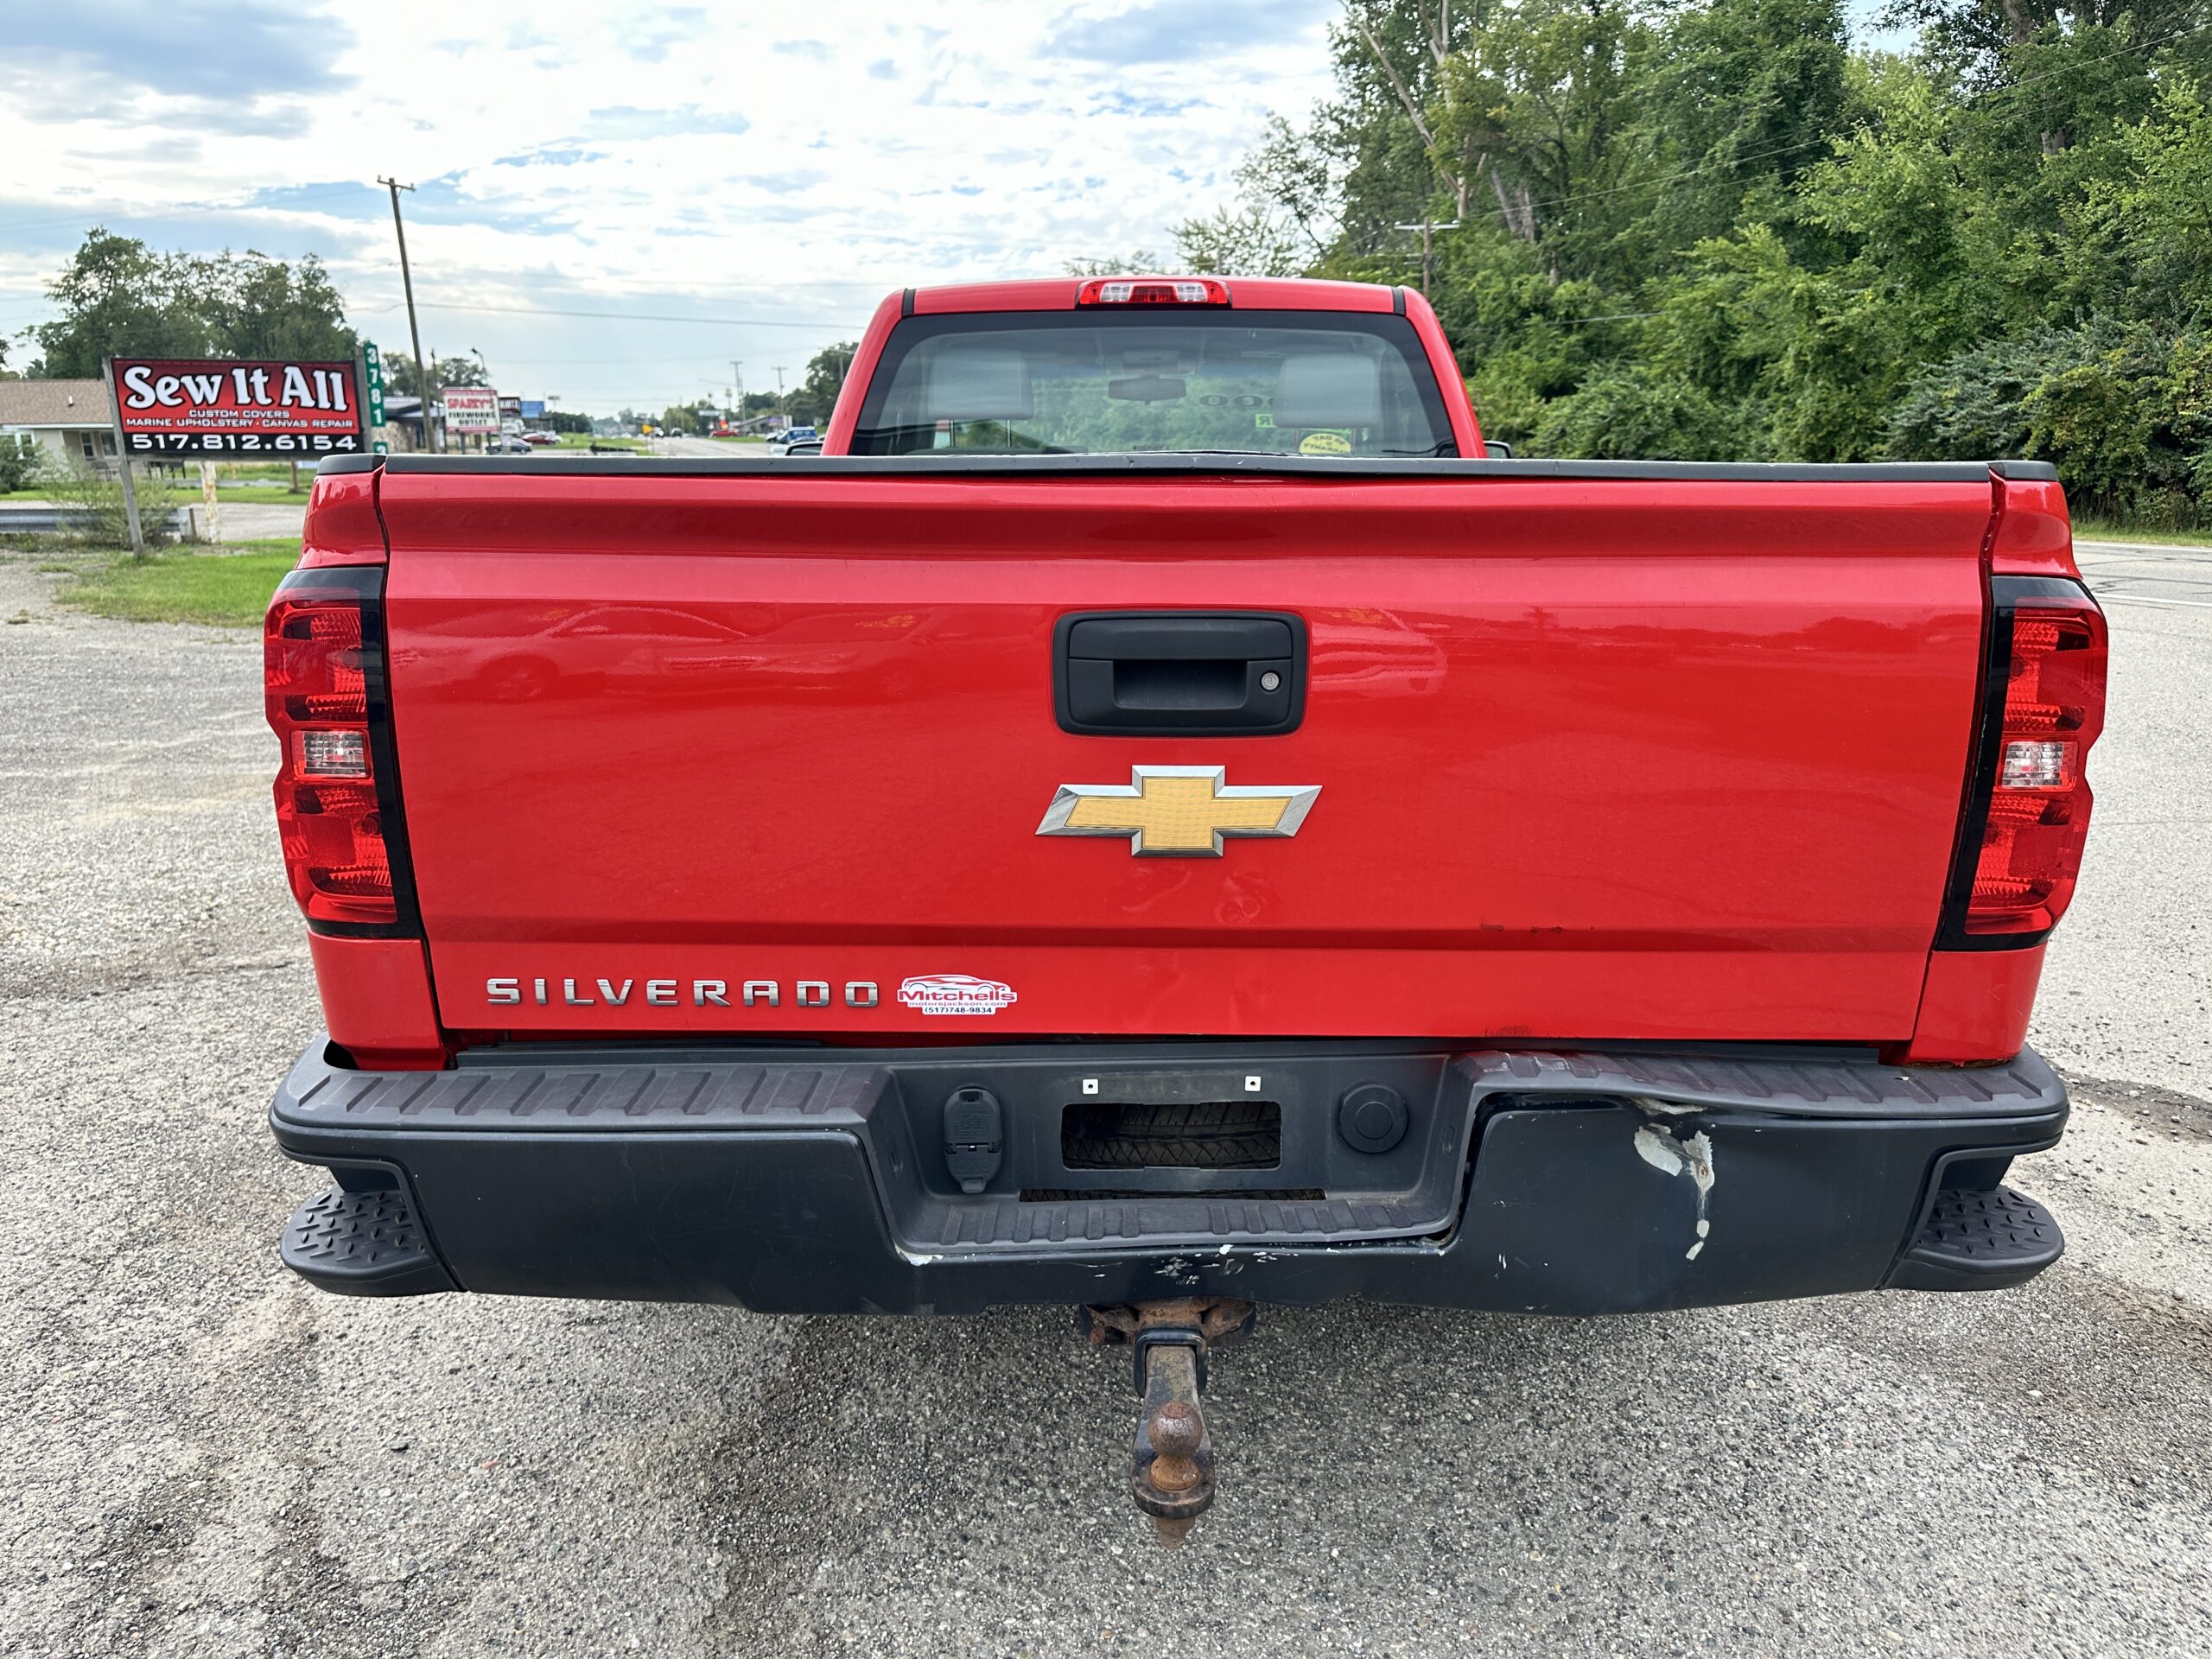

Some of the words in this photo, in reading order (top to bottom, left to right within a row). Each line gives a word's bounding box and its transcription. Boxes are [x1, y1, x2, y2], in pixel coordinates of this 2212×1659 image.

[124, 365, 223, 409] Sew
[232, 367, 272, 406] It
[281, 365, 349, 412] All
[366, 347, 383, 424] 3781
[188, 409, 239, 418] CUSTOM
[242, 410, 290, 419] COVERS
[126, 417, 173, 427] MARINE
[176, 418, 253, 428] UPHOLSTERY
[262, 419, 308, 429] CANVAS
[311, 420, 353, 429] REPAIR
[131, 434, 358, 451] 517.812.6154
[486, 977, 880, 1008] SILVERADO
[899, 990, 1015, 1001] Mitchells
